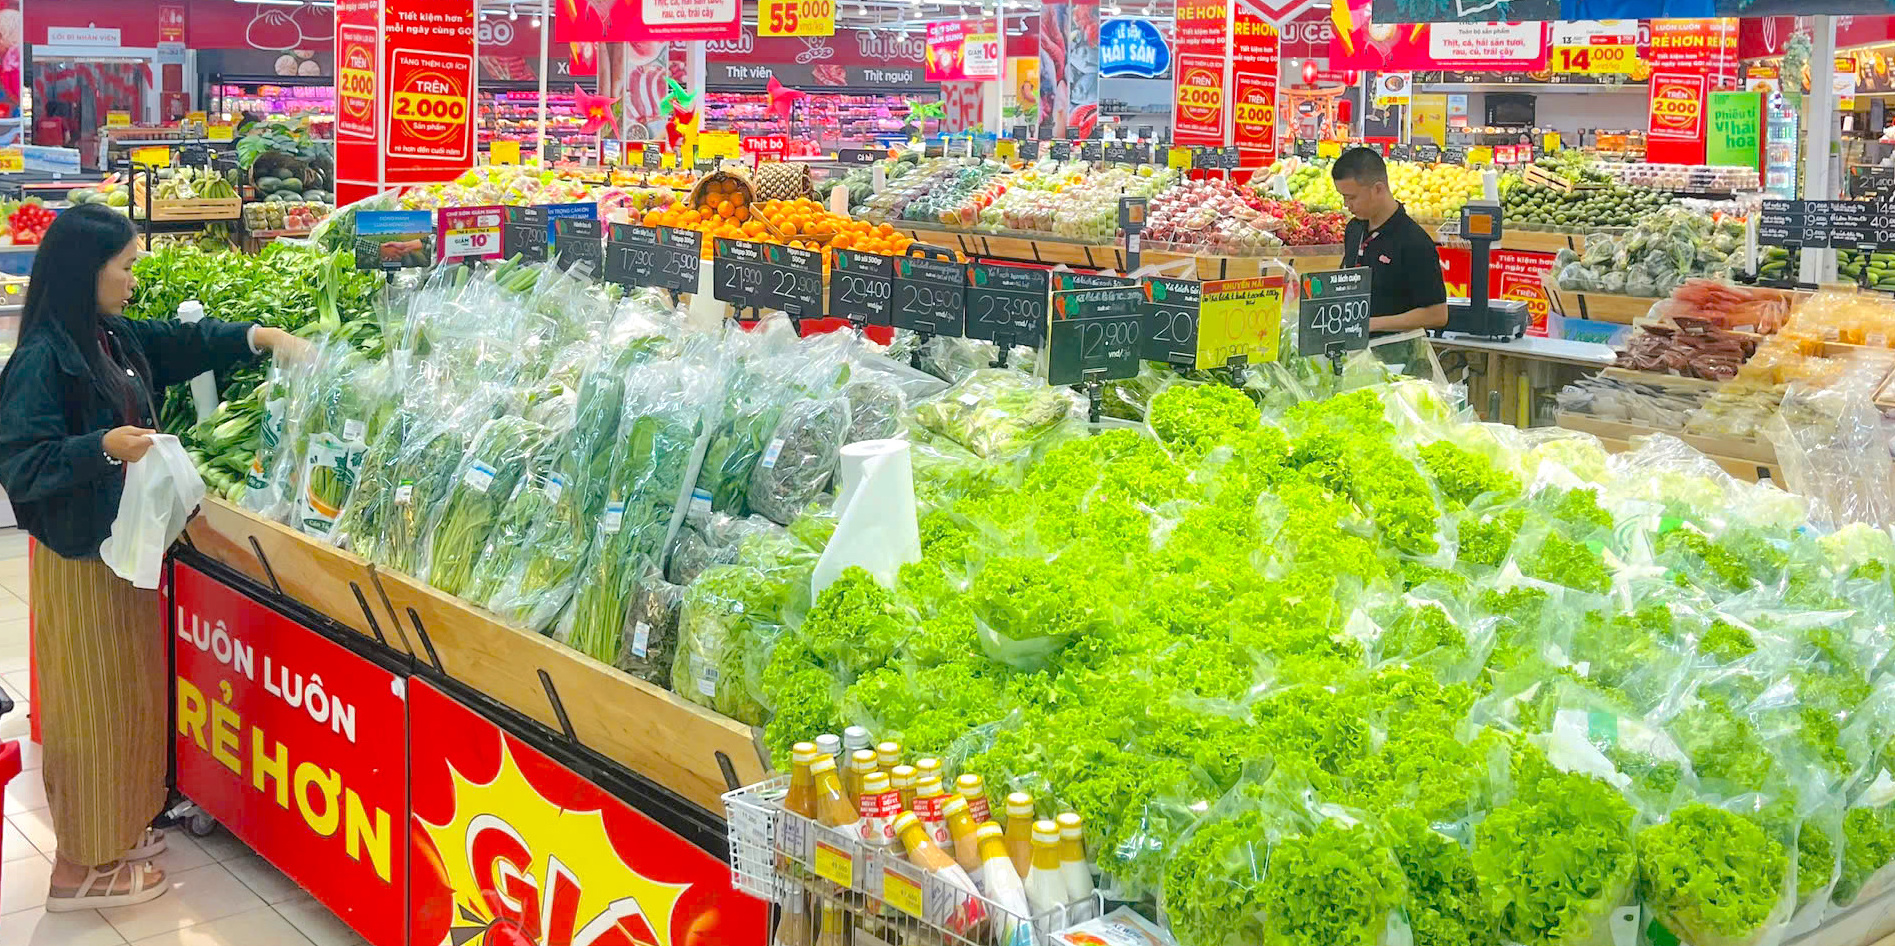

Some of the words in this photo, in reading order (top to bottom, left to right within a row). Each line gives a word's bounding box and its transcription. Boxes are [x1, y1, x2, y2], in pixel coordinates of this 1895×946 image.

[398, 11, 417, 20] Tiết
[420, 12, 443, 22] kiệm
[445, 13, 463, 22] hơn
[770, 0, 830, 33] 55.000
[1196, 4, 1226, 19] HƠN
[385, 22, 403, 33] mỗi
[406, 25, 430, 35] ngày
[432, 26, 455, 36] cùng
[1234, 17, 1250, 35] RẺ
[1651, 32, 1669, 47] RẺ
[1672, 34, 1704, 47] HƠN
[1102, 38, 1125, 63] HẢI
[1129, 39, 1156, 64] SẢN
[1560, 49, 1624, 70] 14.000
[342, 72, 373, 95] 2.000
[726, 66, 748, 80] Thịt
[750, 66, 772, 78] viên
[864, 70, 883, 83] Thịt
[885, 70, 913, 82] nguội
[416, 79, 449, 94] TRÊN
[1181, 89, 1219, 104] 2.000
[396, 97, 463, 119] 2.000
[1238, 107, 1272, 122] 2.000
[1654, 101, 1697, 113] 2.000
[747, 139, 767, 150] Thịt
[515, 226, 548, 247] 37.900
[663, 250, 698, 274] 25.900
[726, 263, 762, 289] 21.900
[772, 270, 820, 299] 22.900
[1222, 280, 1248, 290] KHUYẾN
[841, 275, 891, 303] 29.400
[903, 285, 960, 315] 29.900
[978, 295, 1041, 325] 23.900
[1311, 300, 1368, 335] 48.500
[1074, 321, 1139, 358] 12.900
[178, 605, 254, 681] LUÔN
[264, 655, 356, 744] LUÔN
[177, 675, 241, 778] RẺ
[252, 725, 391, 884] HƠN
